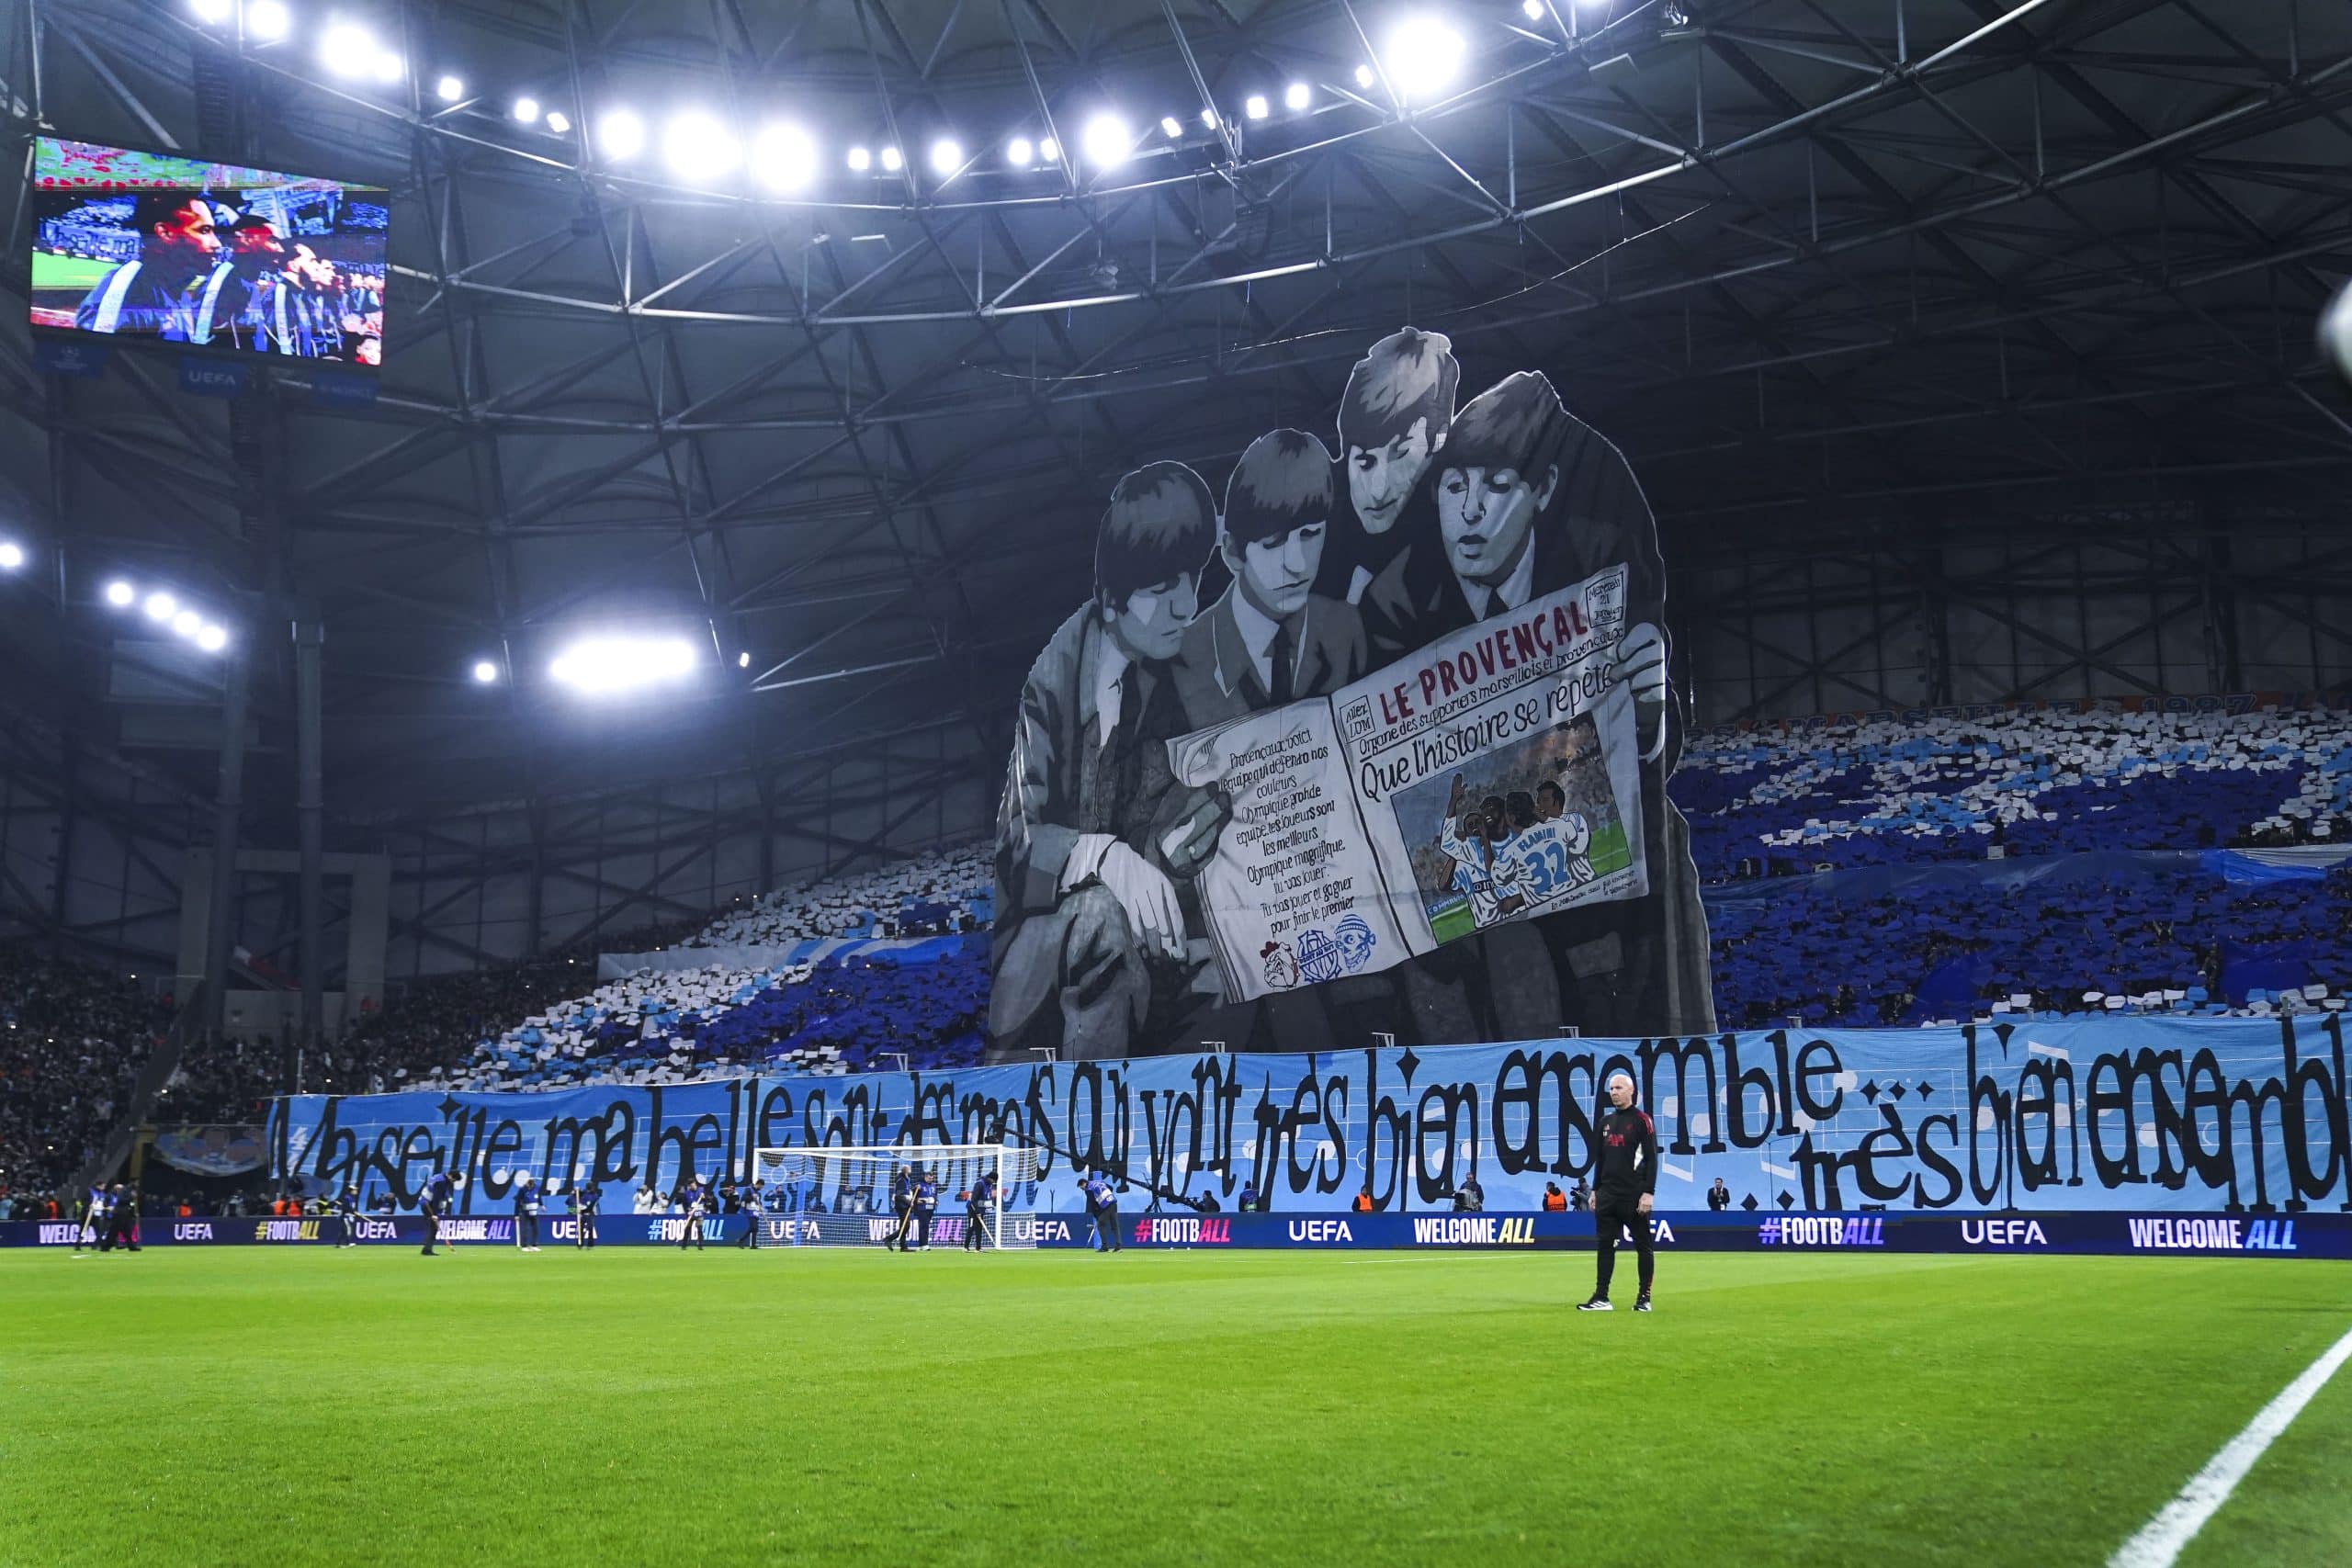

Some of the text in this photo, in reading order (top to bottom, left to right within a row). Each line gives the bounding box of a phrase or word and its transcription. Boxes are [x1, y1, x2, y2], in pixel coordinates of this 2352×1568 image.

[188, 370, 235, 386] UEFA
[1380, 601, 1588, 725] LE PROVENÇAL
[1360, 728, 1399, 756] Organe
[1400, 720, 1418, 735] des
[1419, 690, 1477, 727] supporters
[1286, 728, 1312, 749] voici
[1362, 757, 1411, 803] Que
[1412, 711, 1510, 776] l'histoire
[1514, 699, 1541, 732] se
[1311, 746, 1329, 761] nos
[1257, 775, 1297, 798] couleurs
[1242, 796, 1289, 824] Olympique
[1317, 800, 1335, 817] sont
[1262, 827, 1318, 856] les meilleurs
[1518, 828, 1556, 852] FLAMINI
[1248, 856, 1293, 886] Olympique
[1523, 841, 1570, 895] 32
[1284, 874, 1302, 890] vas
[1261, 902, 1272, 918] Tu
[1272, 899, 1290, 914] vas
[1290, 890, 1312, 911] jouer
[1323, 876, 1353, 901] gagner
[1271, 920, 1291, 938] pour
[1311, 906, 1320, 920] le
[1321, 896, 1354, 922] premier
[538, 1100, 639, 1196] ma
[643, 1078, 794, 1211] belle
[1140, 1054, 1242, 1198] vont
[1365, 1047, 1477, 1212] bien
[1962, 1023, 2083, 1212] bien
[2086, 1012, 2352, 1212] ensembl
[175, 1223, 213, 1241] UEFA
[254, 1221, 320, 1240] #FOOTBALL
[356, 1221, 398, 1239] UEFA
[435, 1220, 511, 1240] WELCOME ALL
[933, 1219, 963, 1241] ALL
[1014, 1220, 1071, 1240] UEFA
[1135, 1218, 1230, 1243] #FOOTBALL
[1289, 1220, 1353, 1241] UEFA
[1414, 1217, 1535, 1243] WELCOME ALL
[1758, 1217, 1883, 1244] #FOOTBALL
[1962, 1220, 2048, 1245] UEFA
[2129, 1219, 2298, 1250] WELCOME ALL
